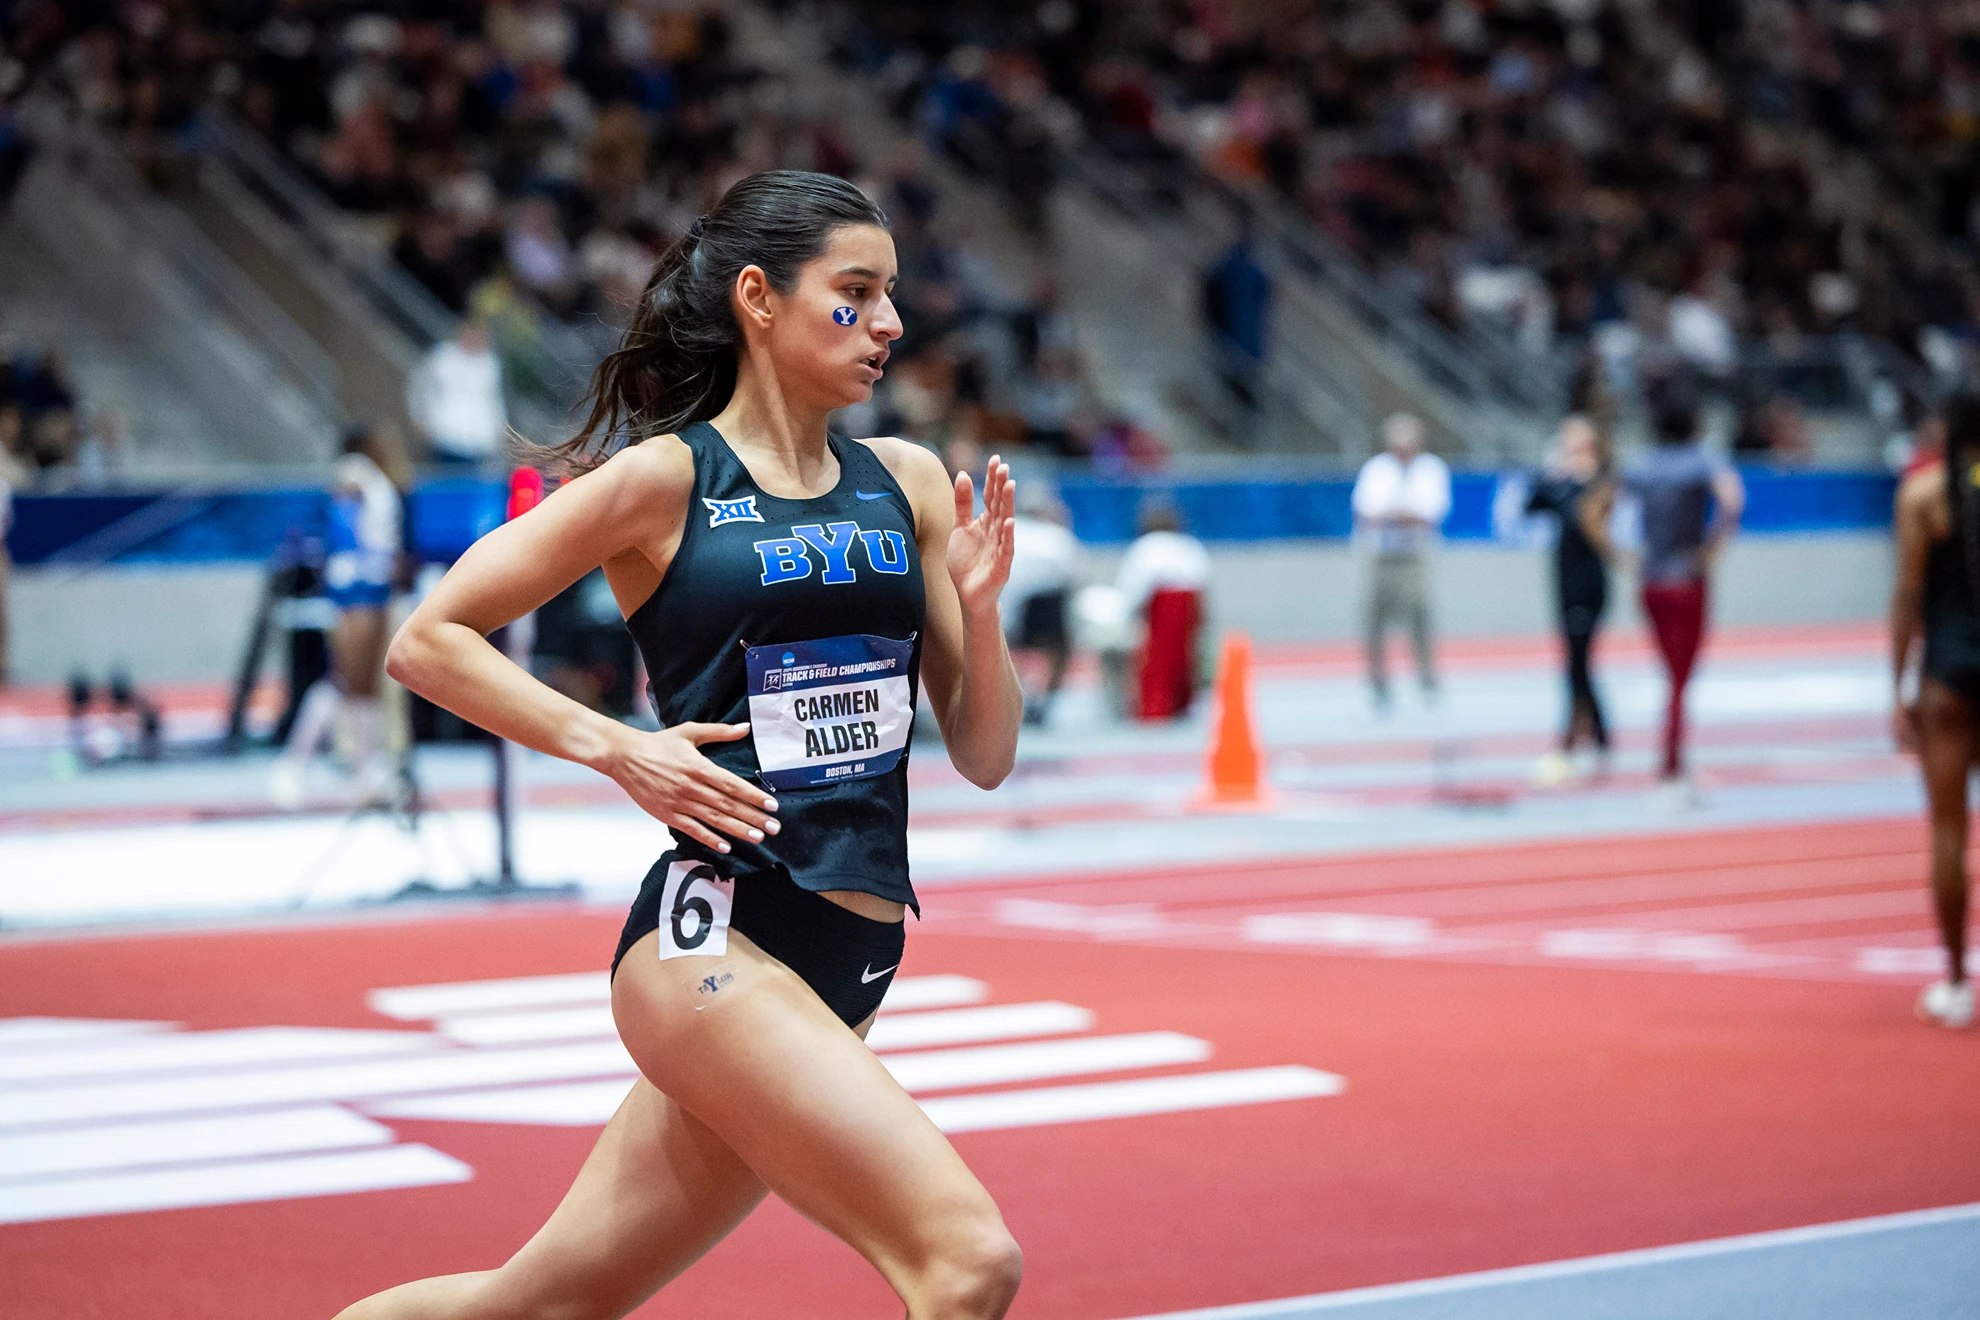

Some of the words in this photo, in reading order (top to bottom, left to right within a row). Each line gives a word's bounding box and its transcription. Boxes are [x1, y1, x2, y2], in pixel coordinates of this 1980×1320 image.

[837, 307, 855, 325] Y
[708, 498, 760, 524] XII
[753, 520, 909, 586] BYU
[782, 669, 808, 683] TRACK
[809, 669, 815, 680] &
[815, 664, 838, 679] FIELD
[839, 658, 896, 676] CHAMPIONSHIPS
[794, 688, 880, 722] CARMEN
[805, 720, 879, 758] ALDER
[825, 764, 853, 778] BOSTON,
[854, 763, 865, 773] MA
[670, 864, 718, 950] 6
